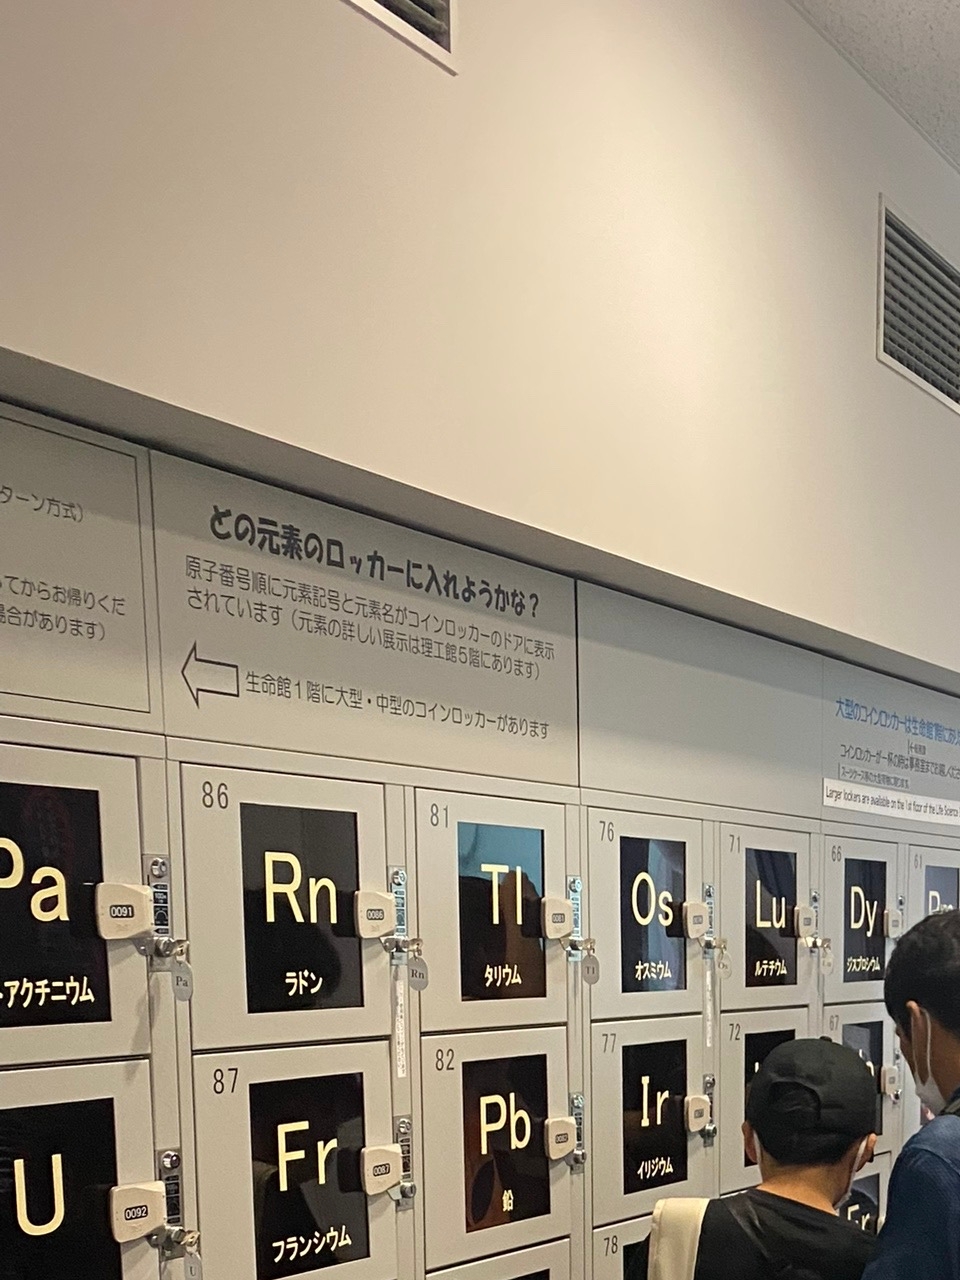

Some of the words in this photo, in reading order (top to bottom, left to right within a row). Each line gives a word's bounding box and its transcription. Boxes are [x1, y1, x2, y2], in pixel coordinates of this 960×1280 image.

[209, 504, 540, 618] どの元素のロッカーに入れようかな？
[0, 575, 126, 616] てからお帰りくだ
[185, 554, 556, 661] 原子番号順に元素記号と元素名がコインロッカーのドアに表示
[202, 781, 229, 809] 86
[430, 803, 449, 829] 81
[600, 820, 614, 843] 76
[729, 834, 741, 854] 71
[831, 845, 842, 863] 66
[264, 851, 338, 924] Rn
[480, 863, 523, 925] Tl
[631, 871, 674, 927] Os
[110, 905, 134, 917] 0091
[756, 880, 786, 928] Lu
[850, 885, 878, 937] Dy
[175, 975, 189, 987] Pa
[410, 967, 425, 980] Rn
[484, 963, 522, 987] タリウム
[635, 960, 672, 981] オスミウム
[755, 959, 788, 977] ルテチウム
[0, 976, 95, 1008] アクチニウム
[285, 969, 323, 996] ラドン
[729, 1023, 741, 1041] 72
[829, 1014, 840, 1031] 67
[602, 1033, 617, 1053] 77
[435, 1048, 455, 1071] 82
[213, 1068, 238, 1094] 87
[641, 1075, 670, 1127] Ir
[480, 1092, 532, 1155] Pb
[278, 1121, 338, 1192] Fr
[637, 1157, 674, 1180] イリジウム
[14, 1154, 65, 1236] U
[502, 1189, 514, 1212] 鉛
[125, 1206, 148, 1220] 0092
[272, 1225, 352, 1263] フランシウム
[603, 1235, 618, 1256] 78
